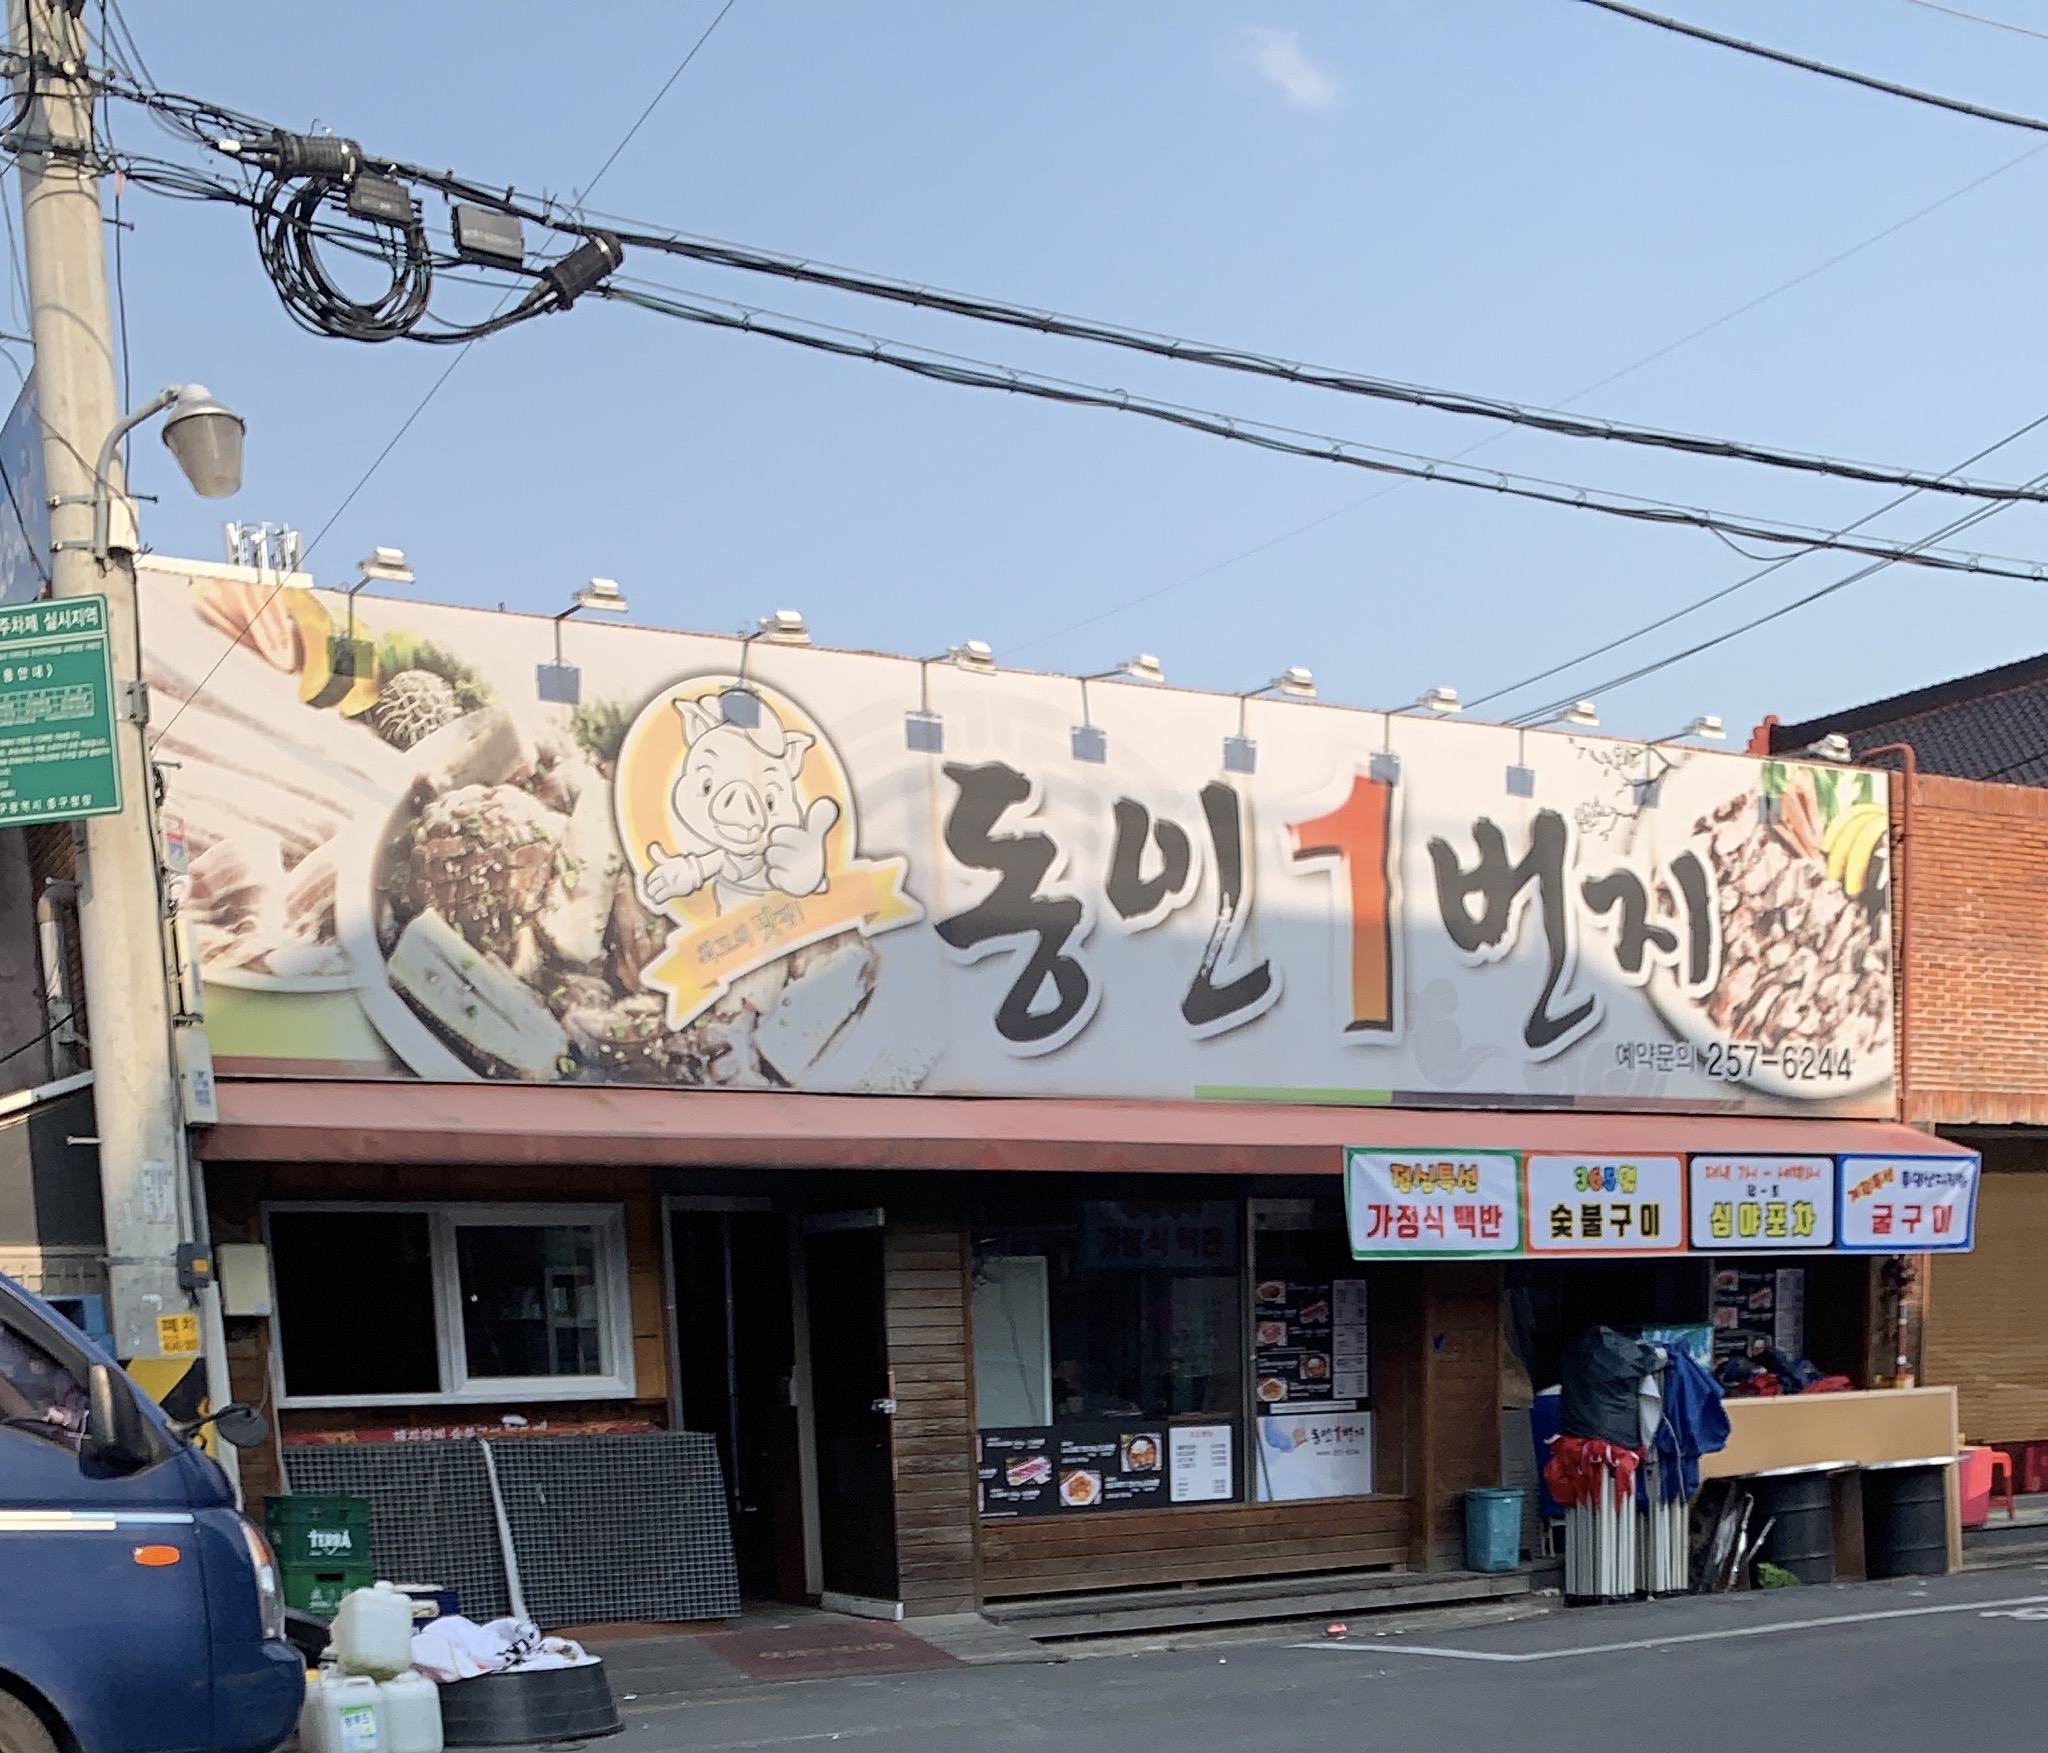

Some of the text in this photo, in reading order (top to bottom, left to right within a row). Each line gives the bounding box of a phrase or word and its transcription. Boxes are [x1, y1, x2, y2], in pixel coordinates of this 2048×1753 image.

[43, 606, 98, 632] 실시지역
[1616, 1042, 1853, 1080] 예약문의 257-6244
[1389, 1163, 1478, 1194] 정성특선
[1573, 1166, 1637, 1193] 365일
[1366, 1203, 1503, 1239] 가정식 백반
[1550, 1203, 1660, 1239] 숯불구이
[1710, 1201, 1816, 1238] 심야포차
[1871, 1204, 1953, 1234] 굴구이
